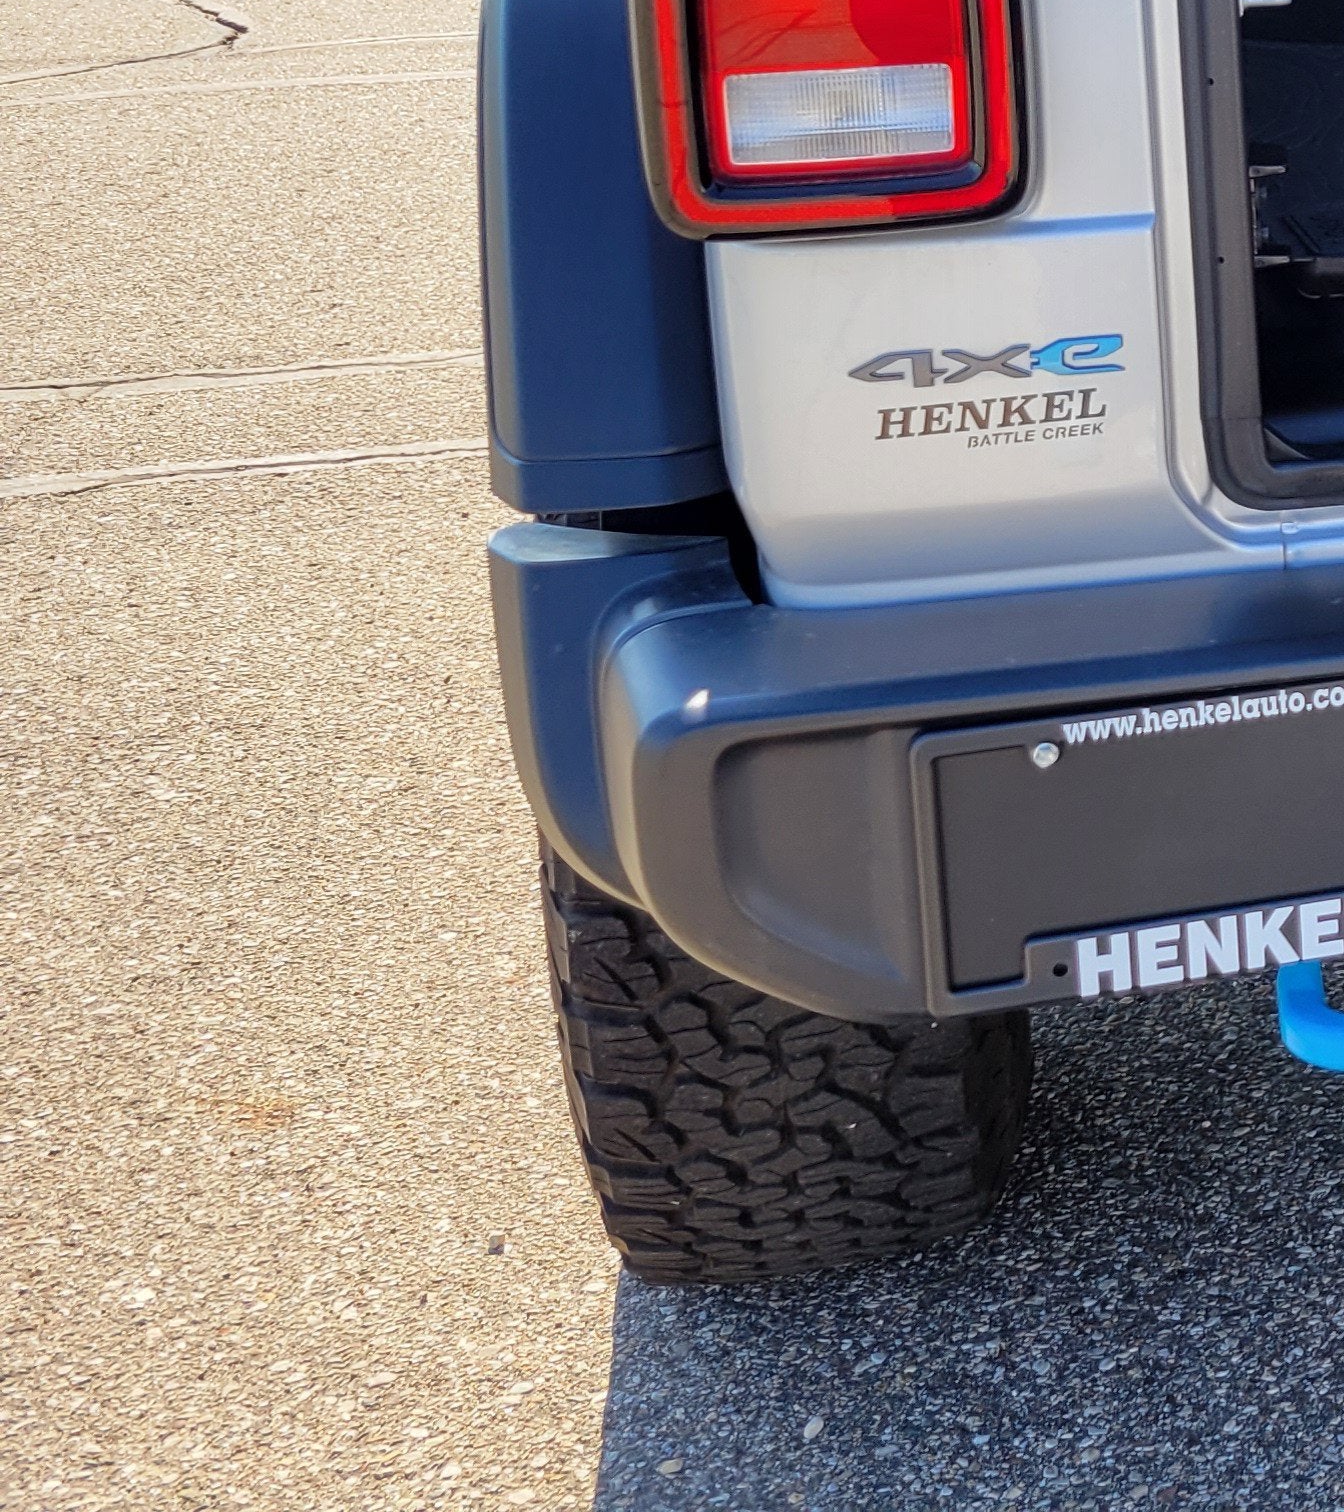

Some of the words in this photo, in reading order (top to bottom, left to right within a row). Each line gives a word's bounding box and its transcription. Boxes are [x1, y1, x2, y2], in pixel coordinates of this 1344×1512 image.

[874, 387, 1108, 441] HENKEL
[966, 429, 1036, 449] BATTLE
[1042, 421, 1105, 441] CREEK
